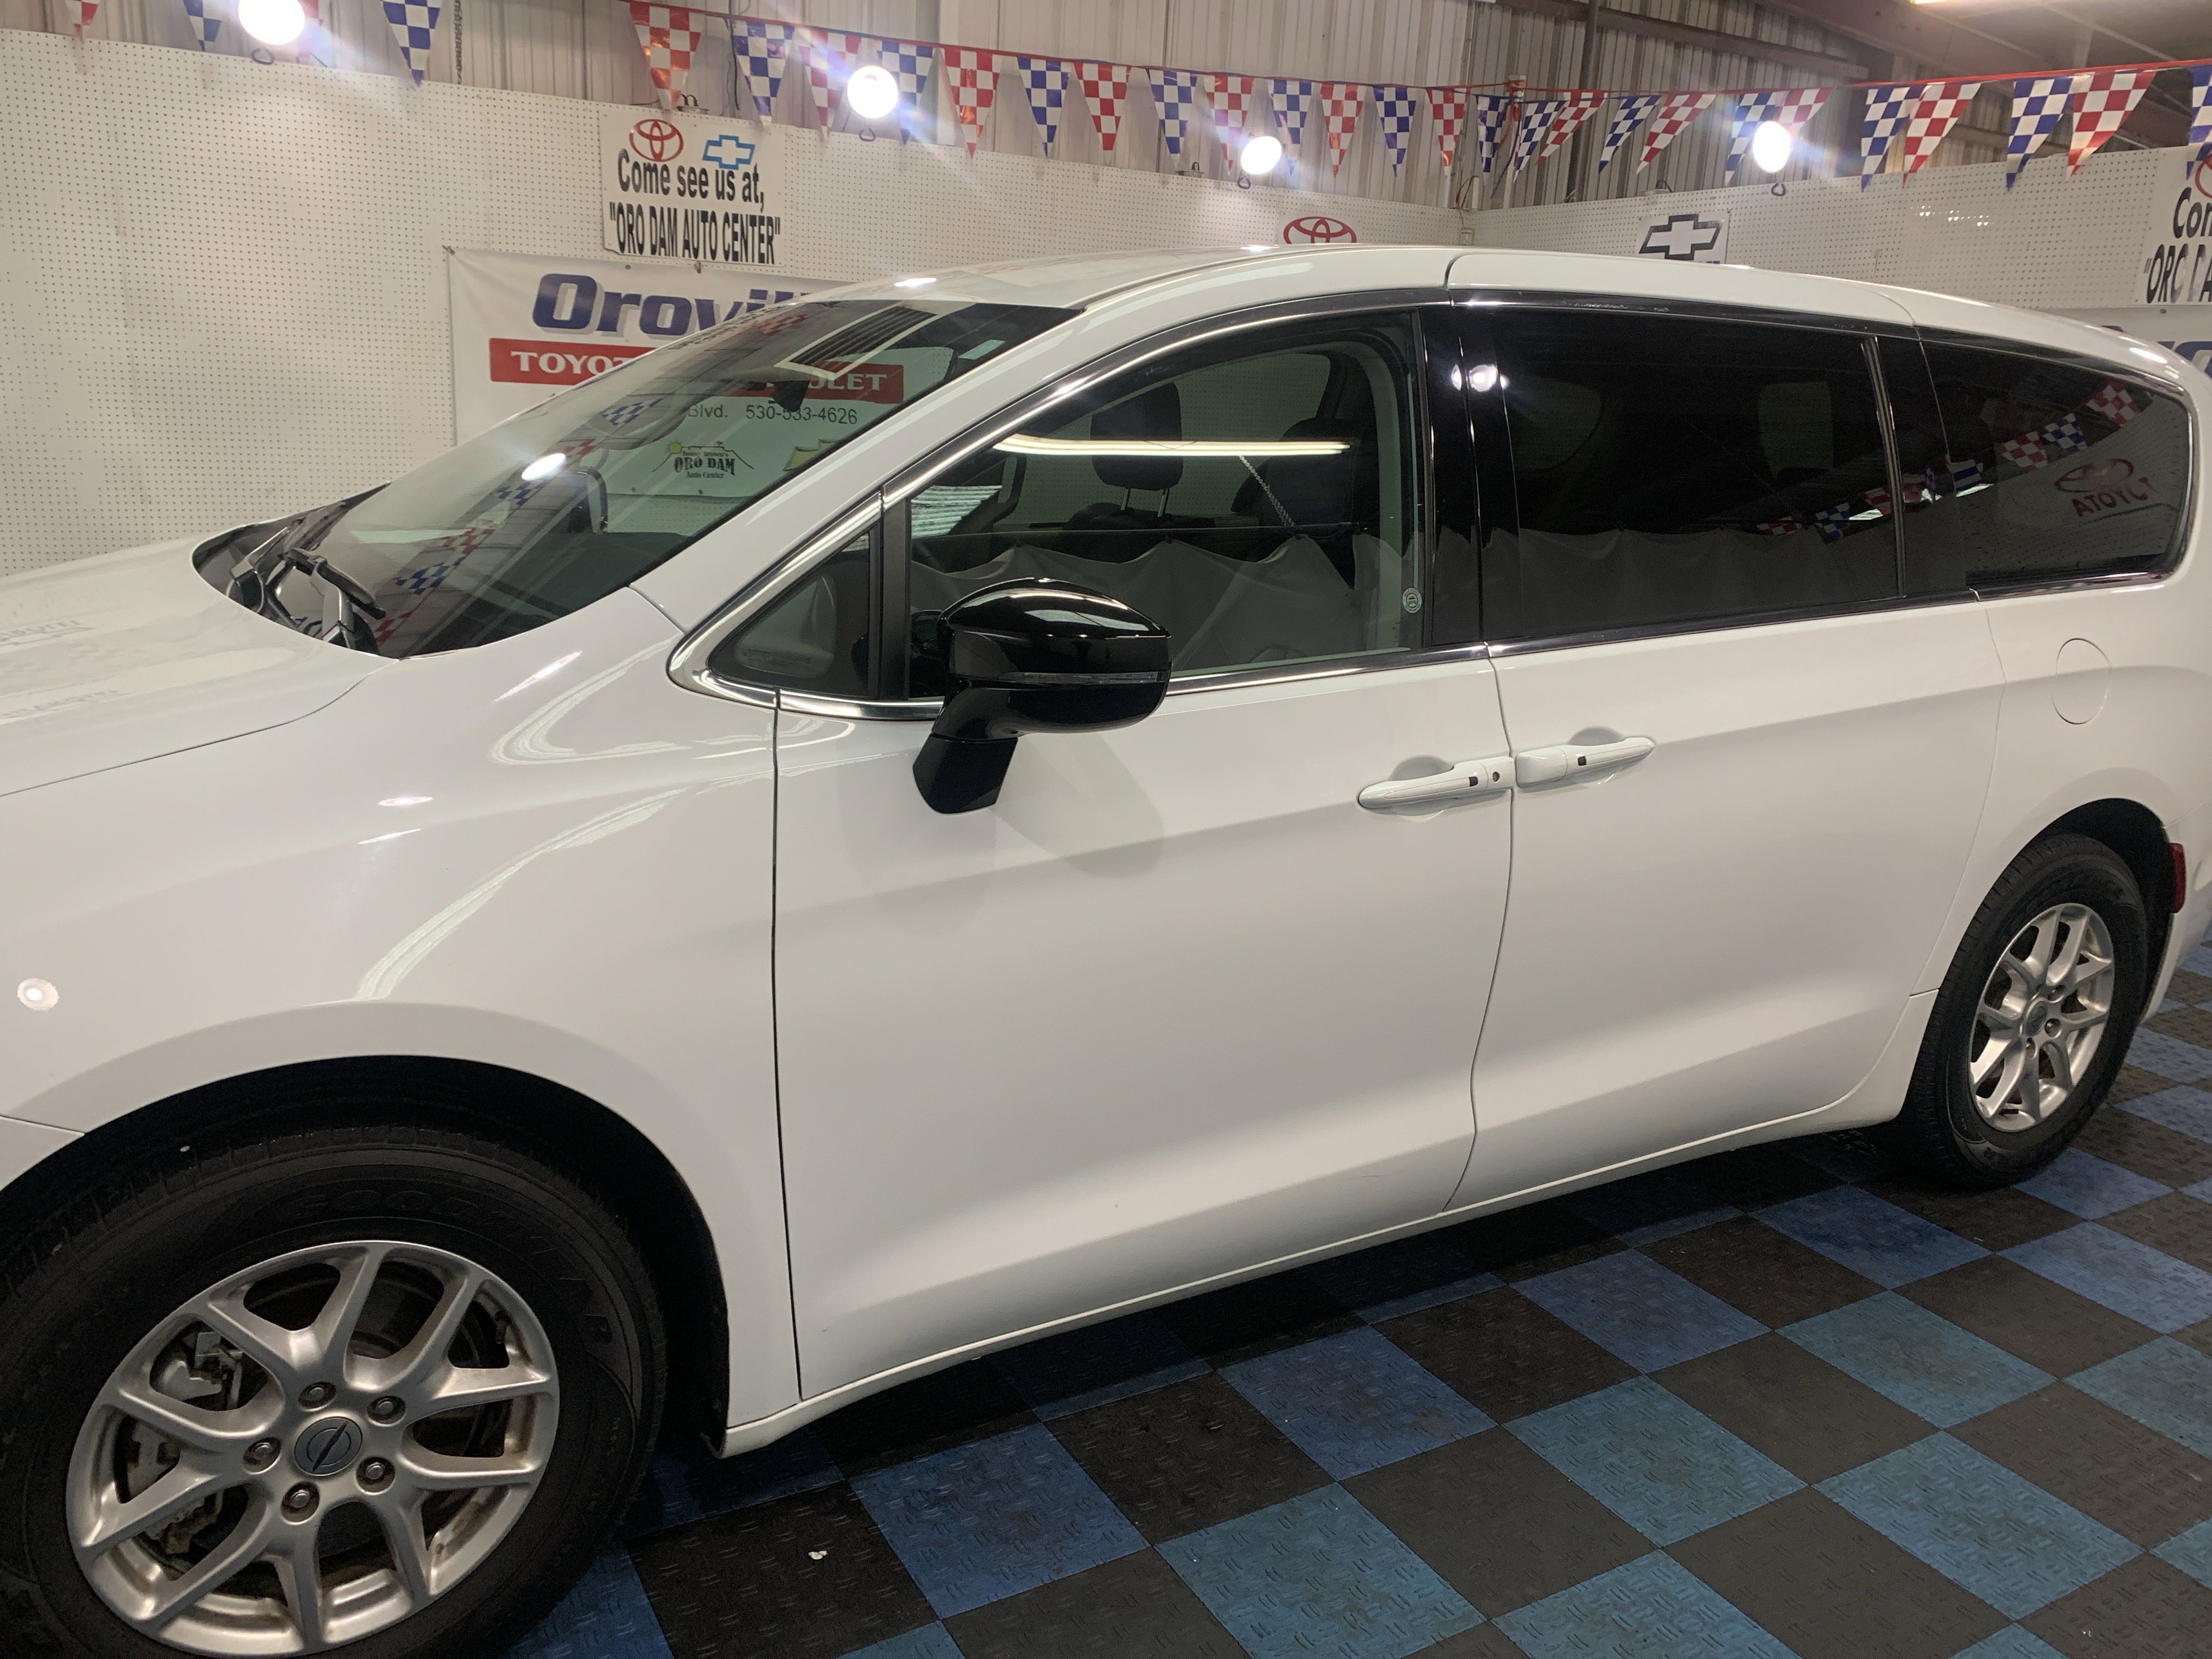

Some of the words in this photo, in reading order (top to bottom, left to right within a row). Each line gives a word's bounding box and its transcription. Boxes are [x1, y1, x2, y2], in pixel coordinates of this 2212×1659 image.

[618, 148, 670, 196] Come
[677, 165, 709, 199] see
[715, 170, 736, 201] us
[742, 163, 764, 213] at,
[609, 201, 645, 255] "ORO
[650, 205, 678, 257] DAM
[682, 208, 718, 261] AUTO
[722, 211, 781, 265] CENTER"
[510, 351, 633, 375] TOYO
[746, 404, 858, 425] 530-533-4626
[675, 457, 703, 473] ORO
[707, 458, 735, 475] DAM
